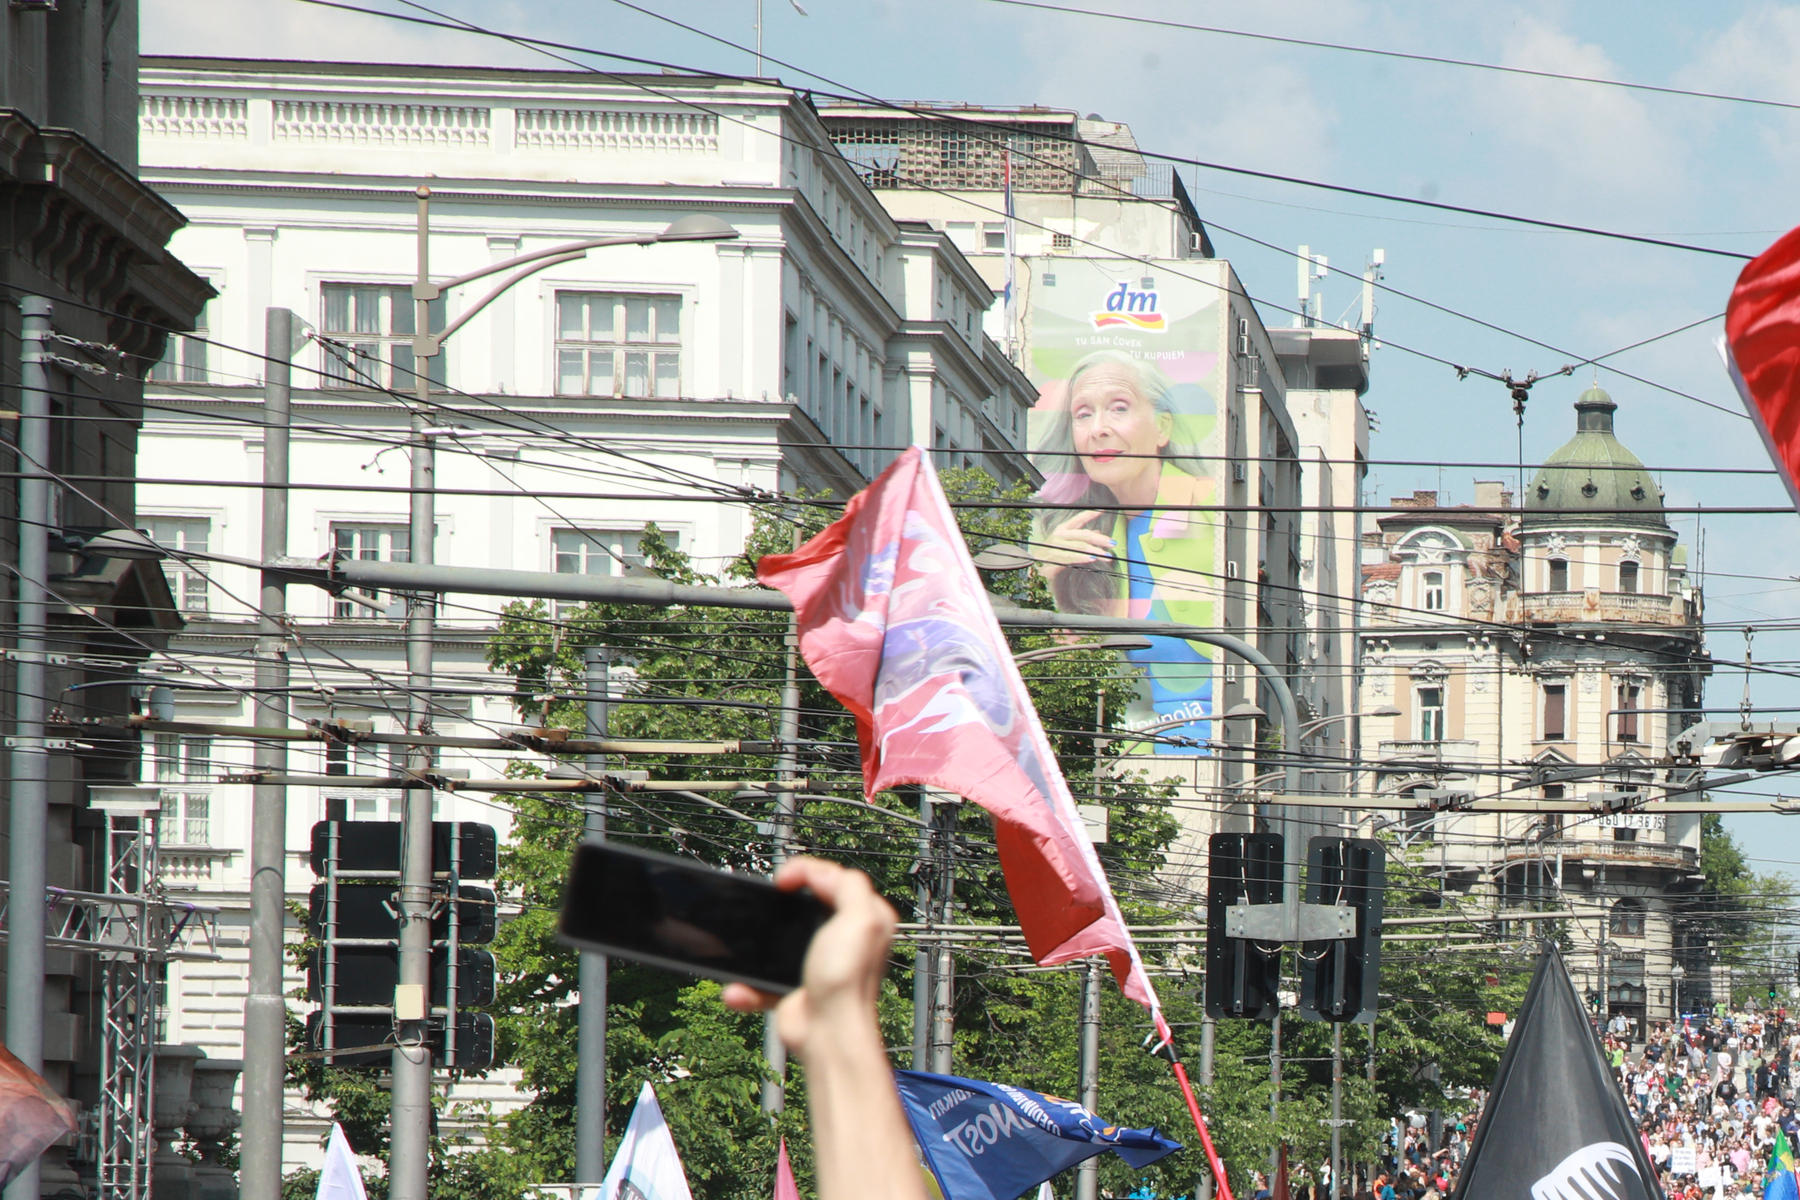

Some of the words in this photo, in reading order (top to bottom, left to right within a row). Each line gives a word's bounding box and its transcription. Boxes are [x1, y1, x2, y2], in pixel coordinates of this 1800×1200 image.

[1106, 282, 1158, 312] dm
[1075, 337, 1087, 346] TU
[1090, 336, 1110, 345] SAM
[1113, 335, 1142, 348] ČOVEK
[1129, 350, 1141, 359] TU
